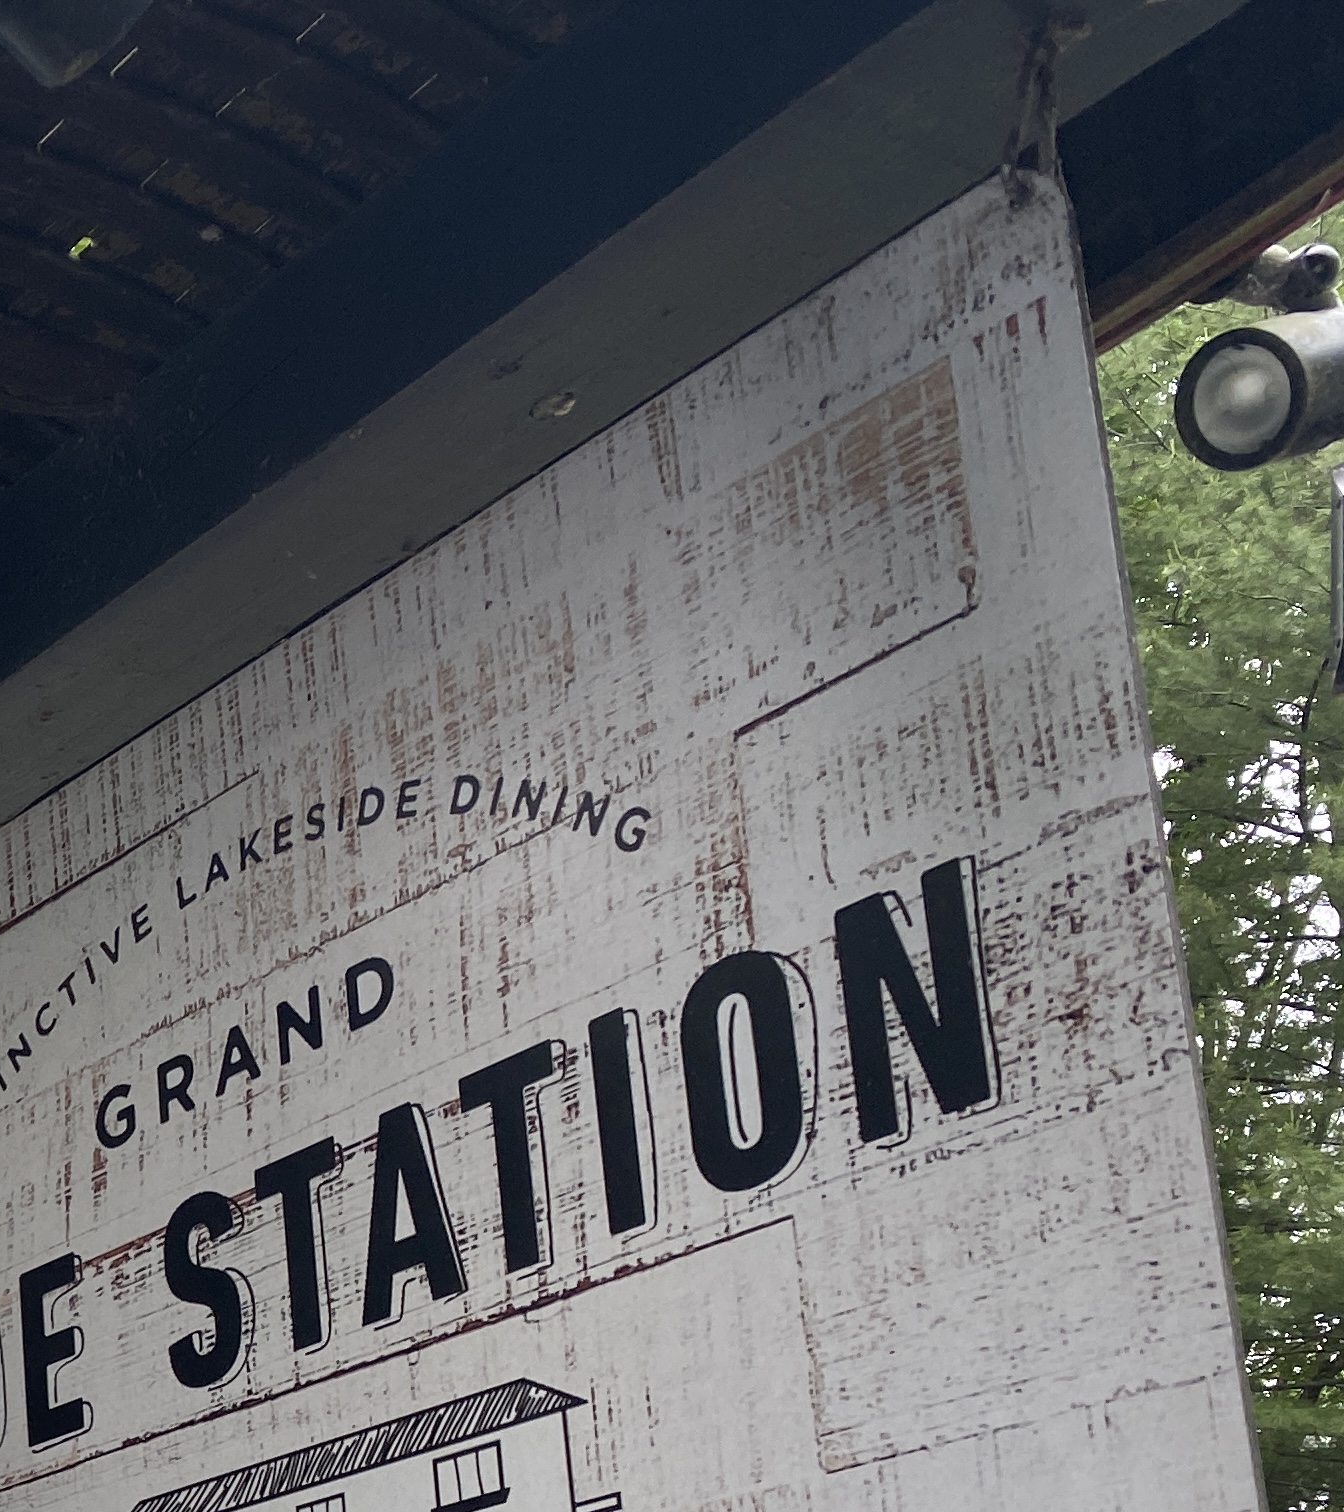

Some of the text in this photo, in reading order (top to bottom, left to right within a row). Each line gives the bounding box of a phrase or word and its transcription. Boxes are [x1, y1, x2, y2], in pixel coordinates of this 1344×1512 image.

[174, 777, 422, 911] LAKESIDE
[449, 774, 649, 853] DINING
[95, 956, 395, 1149] GRAND
[162, 856, 1002, 1391] STATION
